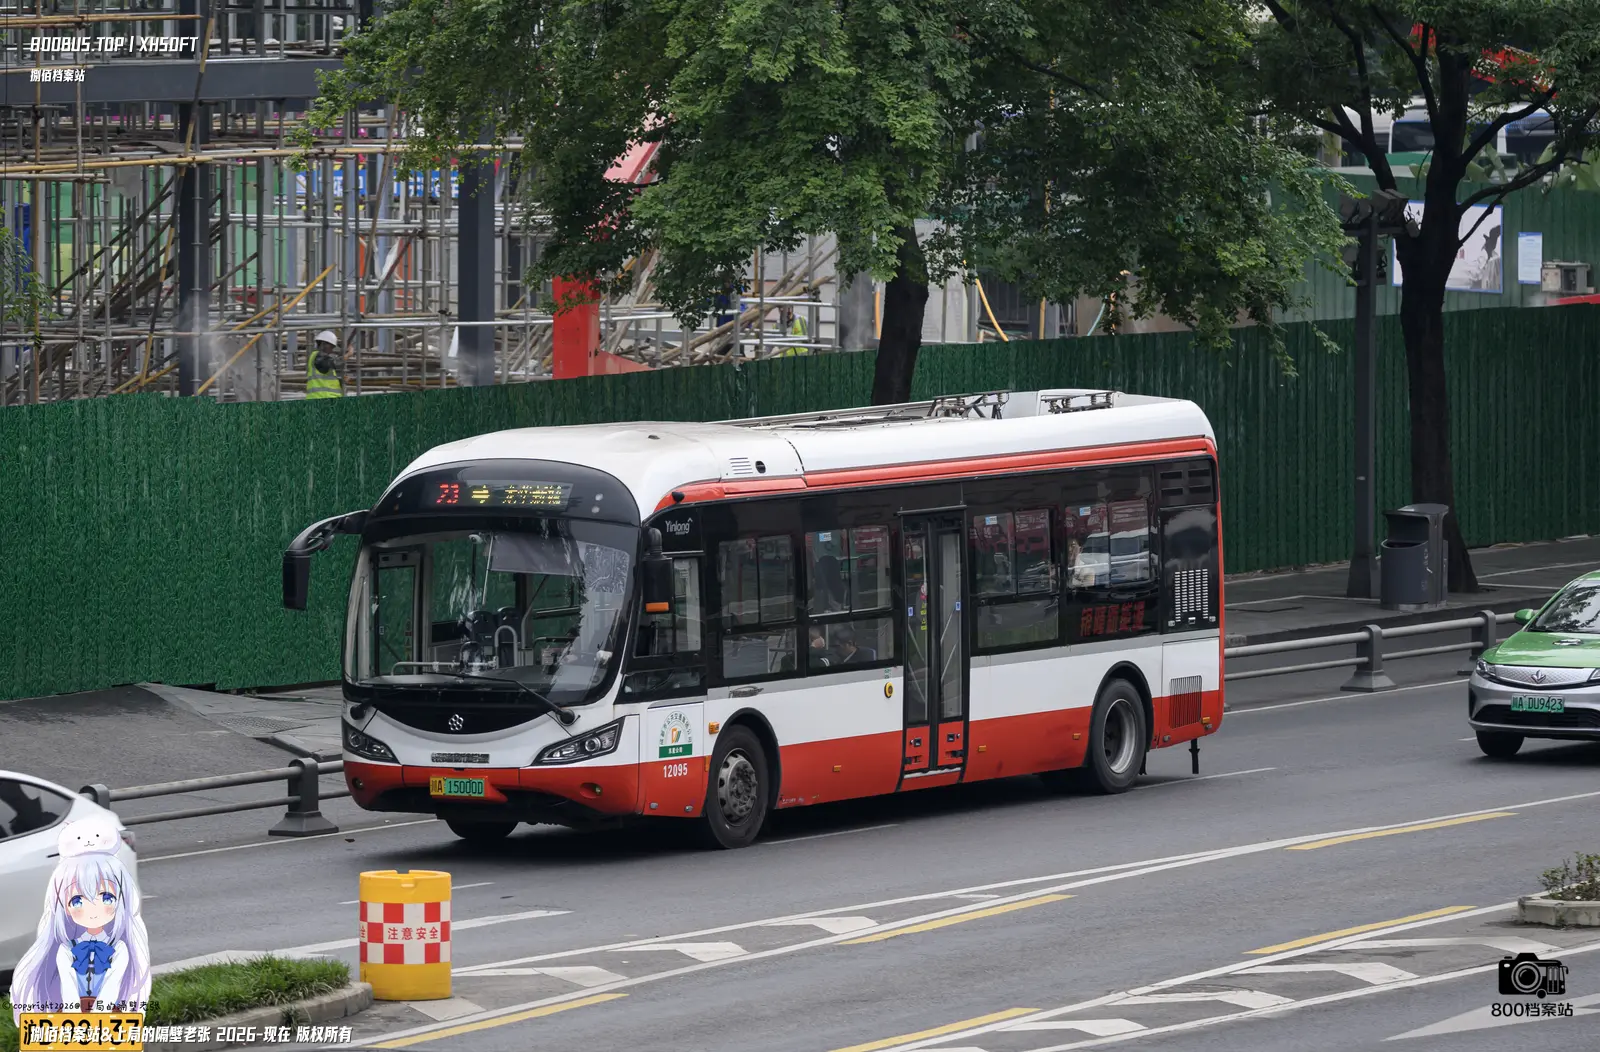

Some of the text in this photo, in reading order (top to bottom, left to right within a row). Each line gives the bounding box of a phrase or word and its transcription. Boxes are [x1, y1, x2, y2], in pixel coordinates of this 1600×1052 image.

[665, 519, 691, 534] Yinlong
[1528, 696, 1563, 711] DU9423
[663, 763, 688, 778] 12095
[388, 926, 438, 941] 注意安全
